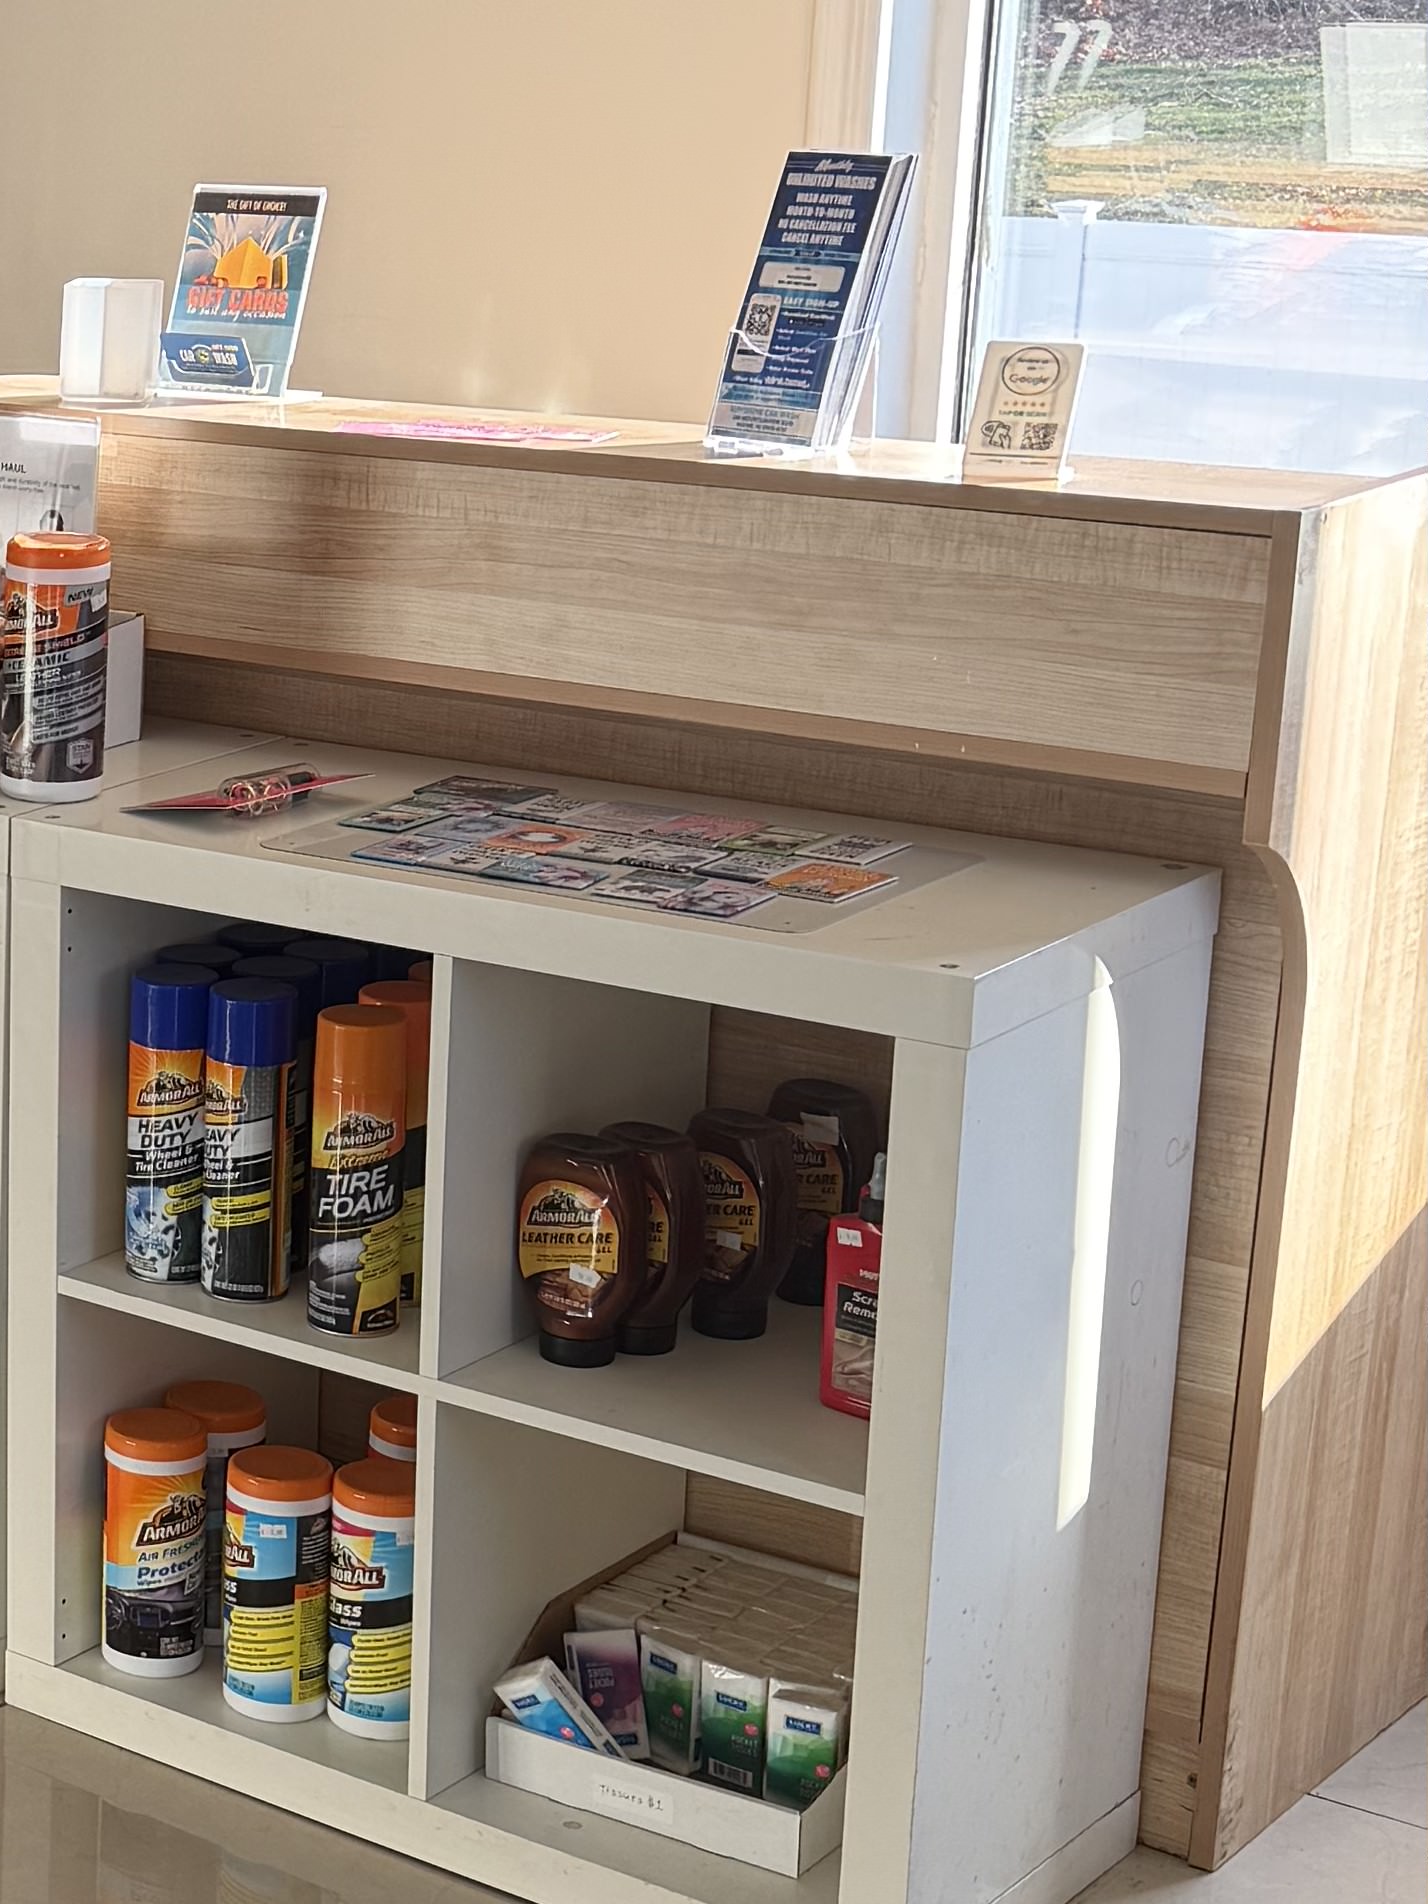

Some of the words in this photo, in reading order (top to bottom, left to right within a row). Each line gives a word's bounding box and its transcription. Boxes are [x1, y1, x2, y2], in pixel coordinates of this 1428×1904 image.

[786, 172, 835, 188] UNLIMITED
[834, 174, 877, 190] WASHES
[188, 286, 225, 310] GIFT
[229, 287, 289, 313] CARDS
[1009, 373, 1048, 386] Google
[1, 462, 27, 474] HAUL
[138, 1112, 199, 1134] HEAVY
[140, 1130, 191, 1148] DUTY
[205, 1128, 241, 1143] EAVY
[145, 1146, 182, 1161] Wheel
[186, 1145, 193, 1155] &
[205, 1145, 231, 1158] UTY
[330, 1148, 388, 1169] Extreme
[135, 1160, 154, 1172] Tire
[155, 1154, 199, 1171] Cleaner
[205, 1157, 223, 1170] heel
[225, 1161, 233, 1171] &
[327, 1164, 389, 1196] TIRE
[806, 1173, 838, 1185] CARE
[318, 1184, 394, 1218] FOAM
[724, 1204, 755, 1216] CARE
[522, 1232, 574, 1245] LEATHER
[577, 1232, 614, 1244] CARE
[138, 1551, 159, 1563] AIR
